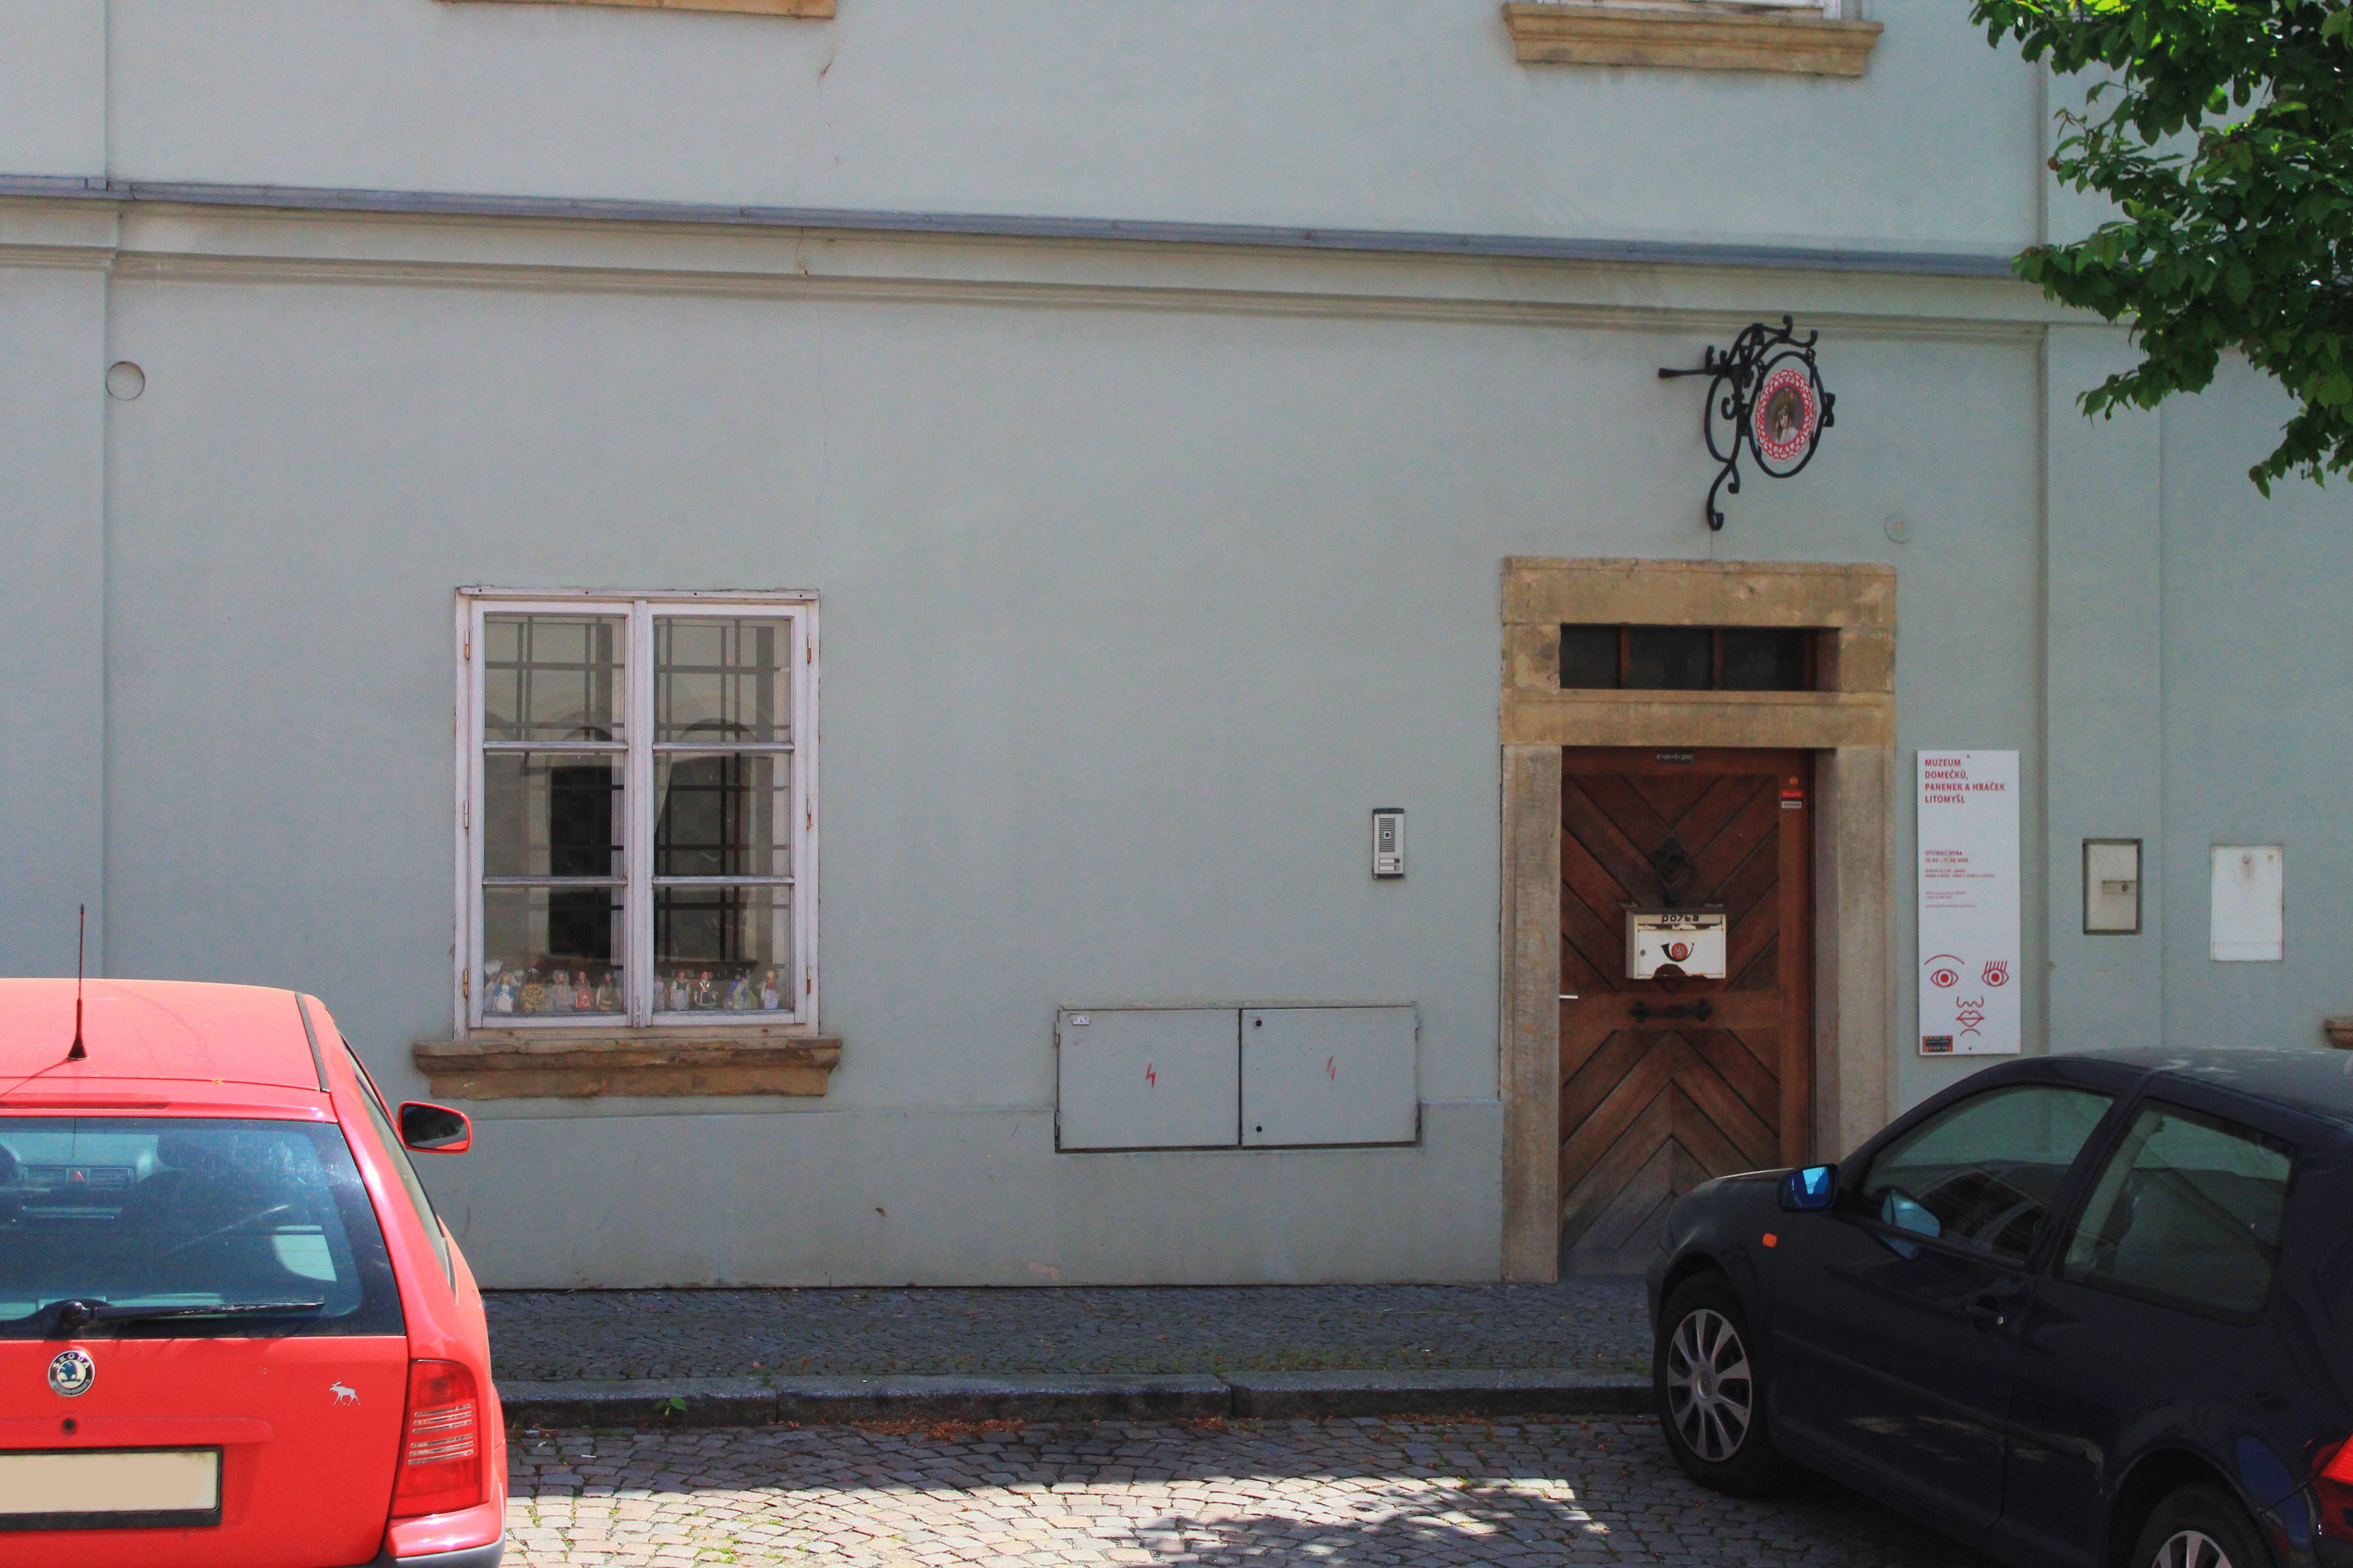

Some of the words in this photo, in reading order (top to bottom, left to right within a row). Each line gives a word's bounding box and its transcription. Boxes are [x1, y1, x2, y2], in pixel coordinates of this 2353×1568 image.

[1925, 759, 1961, 767] MUZEUM
[1925, 783, 1963, 791] PANENEK
[1972, 781, 2006, 791] HRAČEK
[1925, 793, 1966, 803] LITOMYŠL
